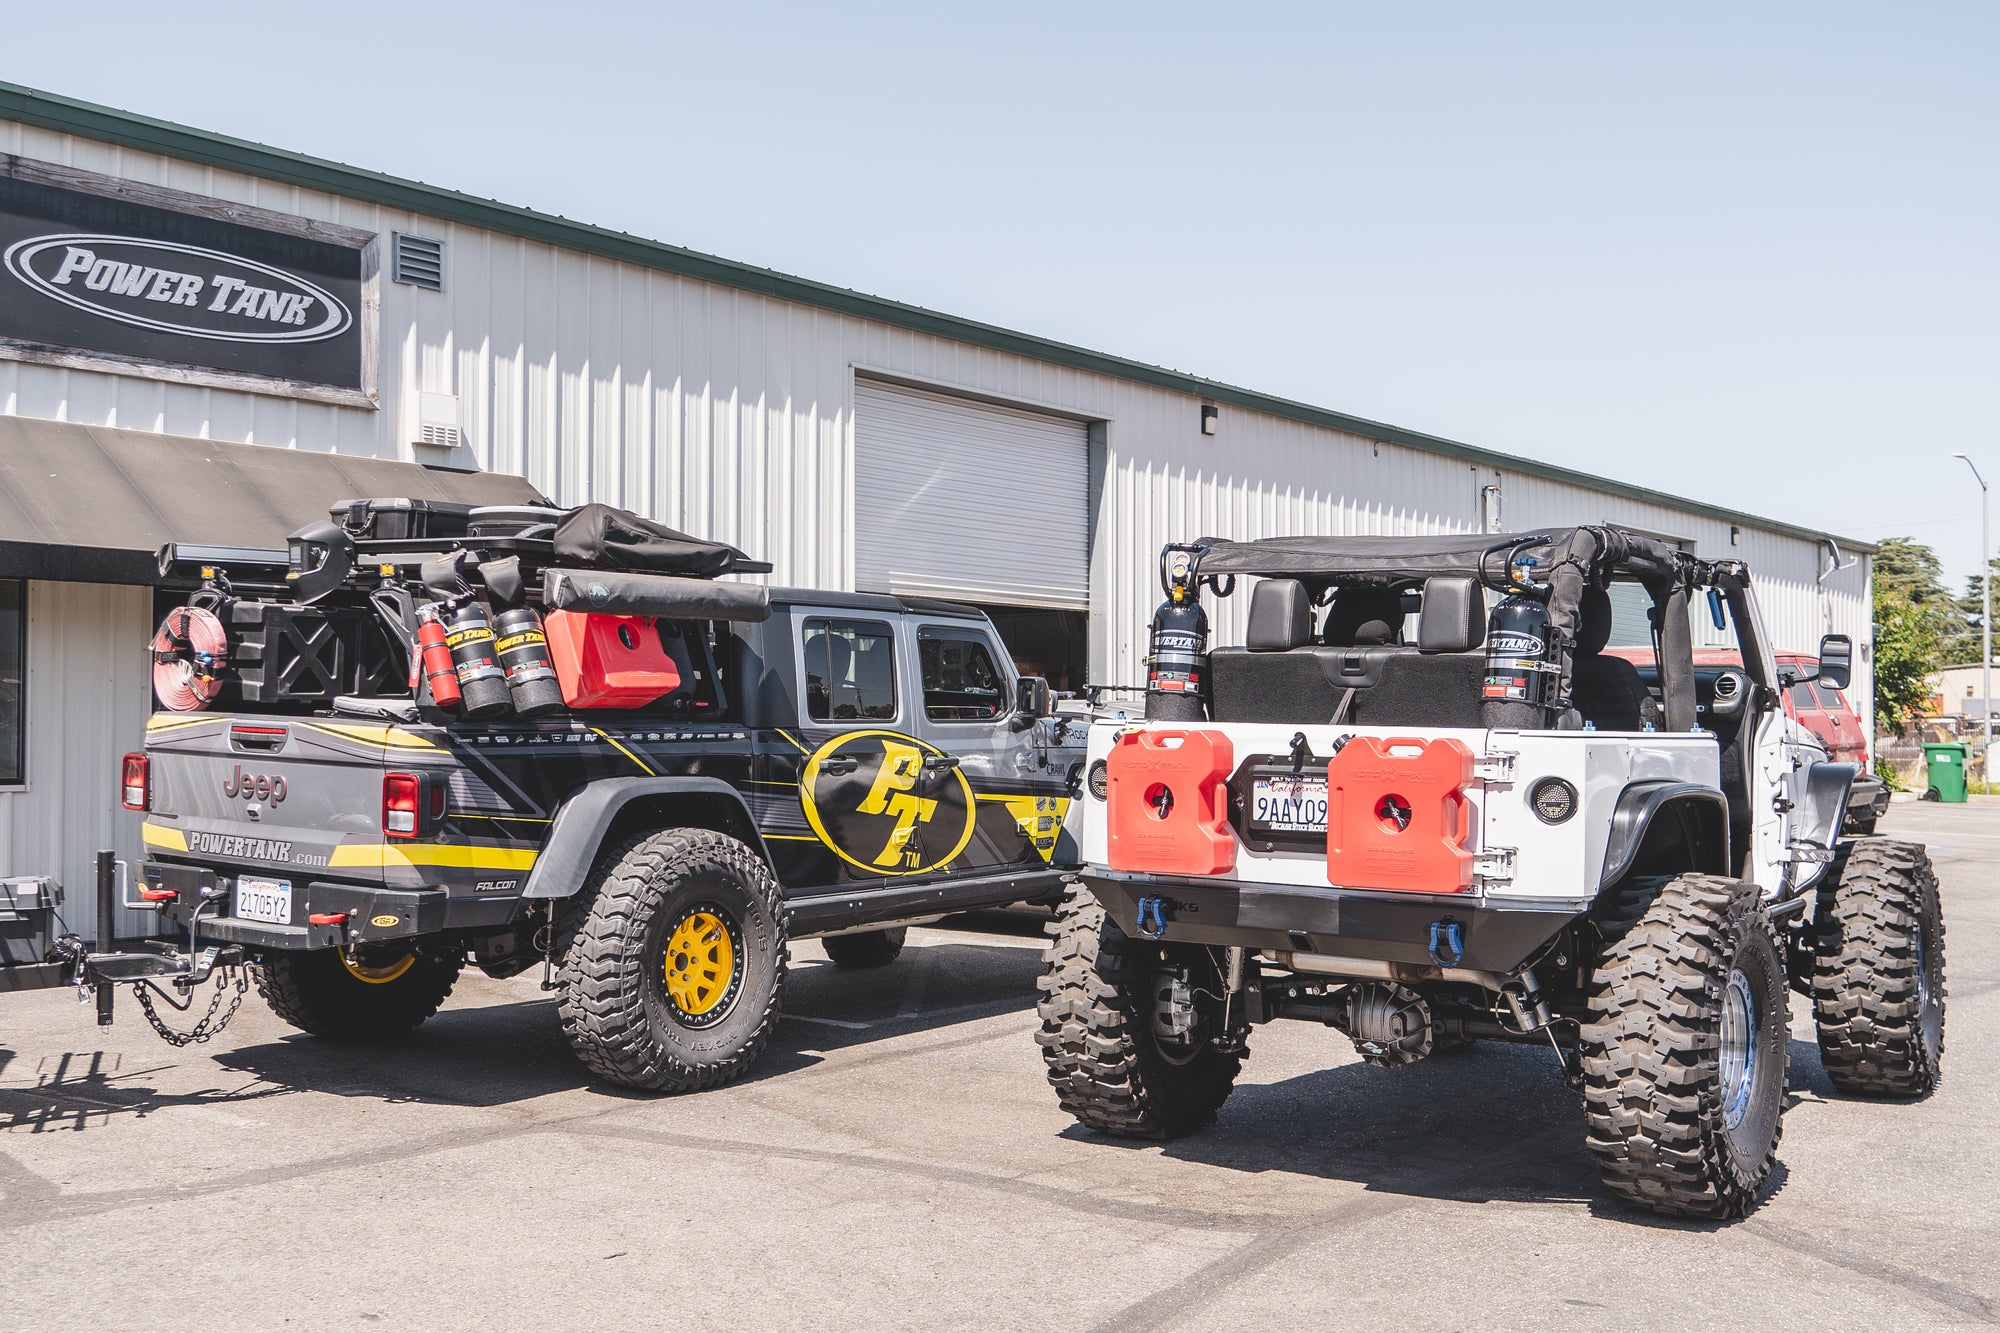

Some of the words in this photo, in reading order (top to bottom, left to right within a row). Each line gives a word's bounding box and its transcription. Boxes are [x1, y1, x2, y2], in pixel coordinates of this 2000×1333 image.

[51, 246, 205, 307] POWER
[207, 275, 314, 325] TANK
[223, 764, 289, 808] Jeep
[1257, 781, 1269, 789] JAN
[1257, 797, 1328, 823] 9AAY09
[475, 880, 518, 892] FALCON
[240, 892, 287, 917] 21705Y2
